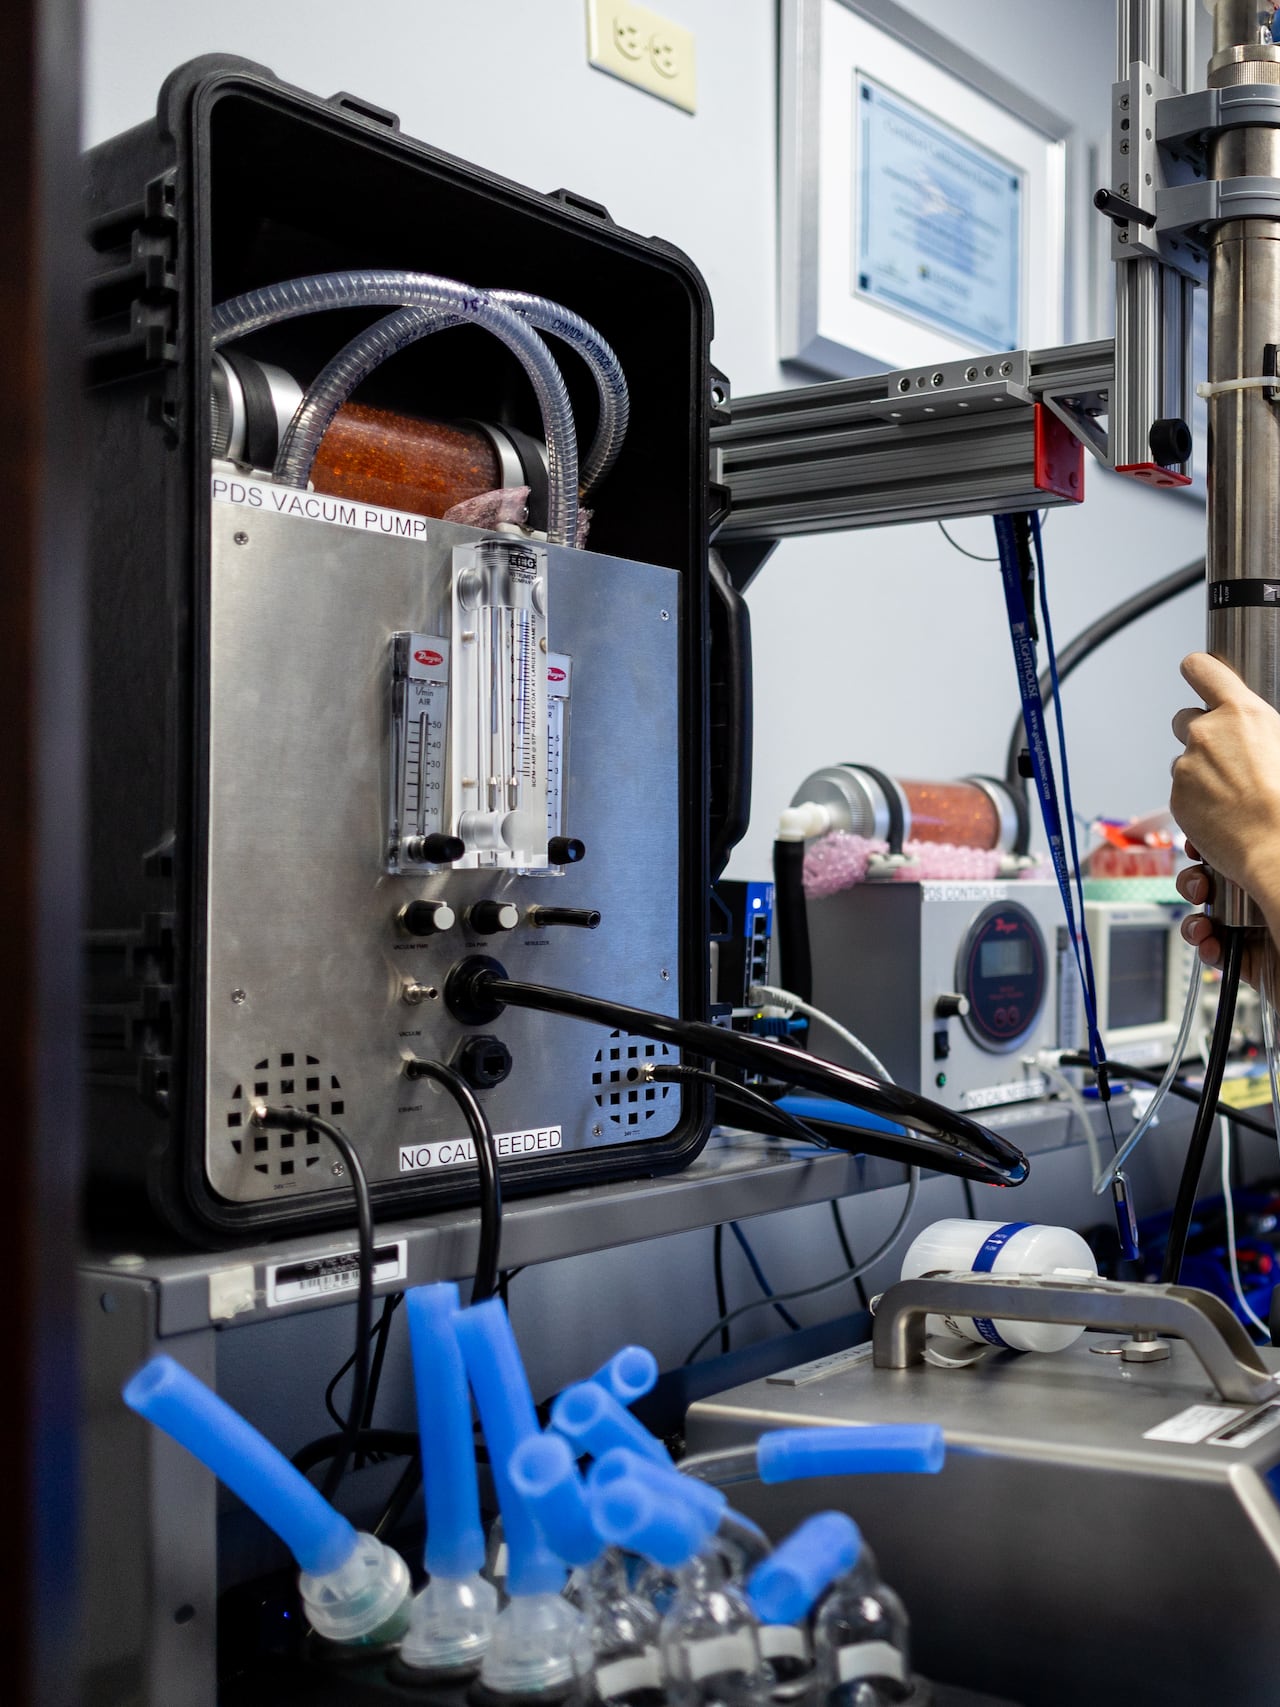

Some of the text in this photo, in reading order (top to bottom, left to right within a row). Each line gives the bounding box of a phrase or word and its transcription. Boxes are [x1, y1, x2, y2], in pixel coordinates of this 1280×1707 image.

[212, 479, 426, 538] PDS VACUM PUMP
[432, 721, 442, 729] 50
[432, 741, 441, 749] 40
[431, 760, 441, 768] 30
[430, 782, 440, 790] 20
[430, 807, 439, 815] 10
[401, 1130, 561, 1169] NO CAL EEDED
